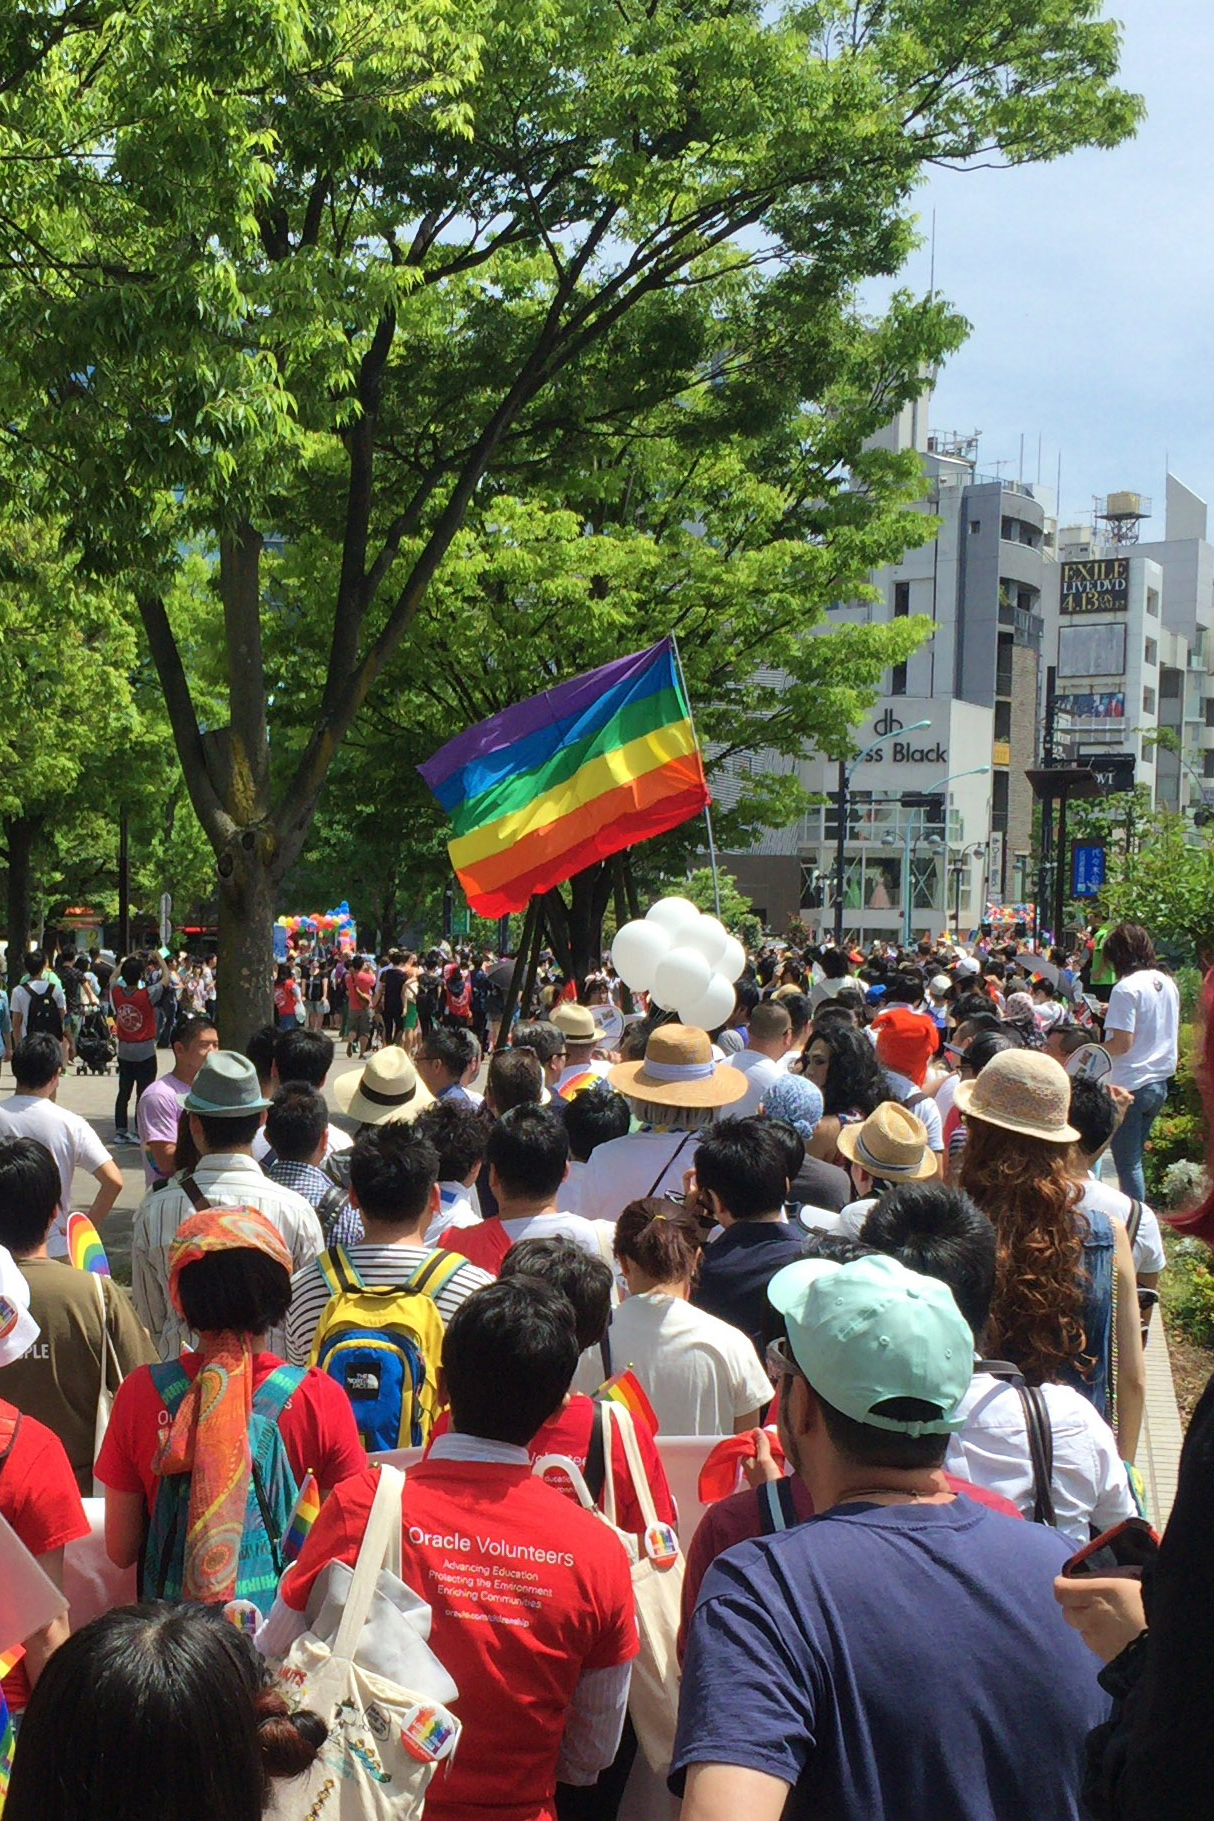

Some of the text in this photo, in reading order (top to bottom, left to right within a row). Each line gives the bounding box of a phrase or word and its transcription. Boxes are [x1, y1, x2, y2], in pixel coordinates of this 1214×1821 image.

[1064, 561, 1126, 582] EXILE
[1063, 578, 1126, 594] LIVE DVD
[1062, 589, 1099, 612] 4.13
[892, 742, 947, 763] Black
[17, 1343, 50, 1360] PLE
[409, 1526, 574, 1567] Oracle Volunteers
[443, 1559, 538, 1581] Advancing Education
[429, 1570, 553, 1597] Protecting the Environment
[437, 1585, 542, 1609] Enriching Communities
